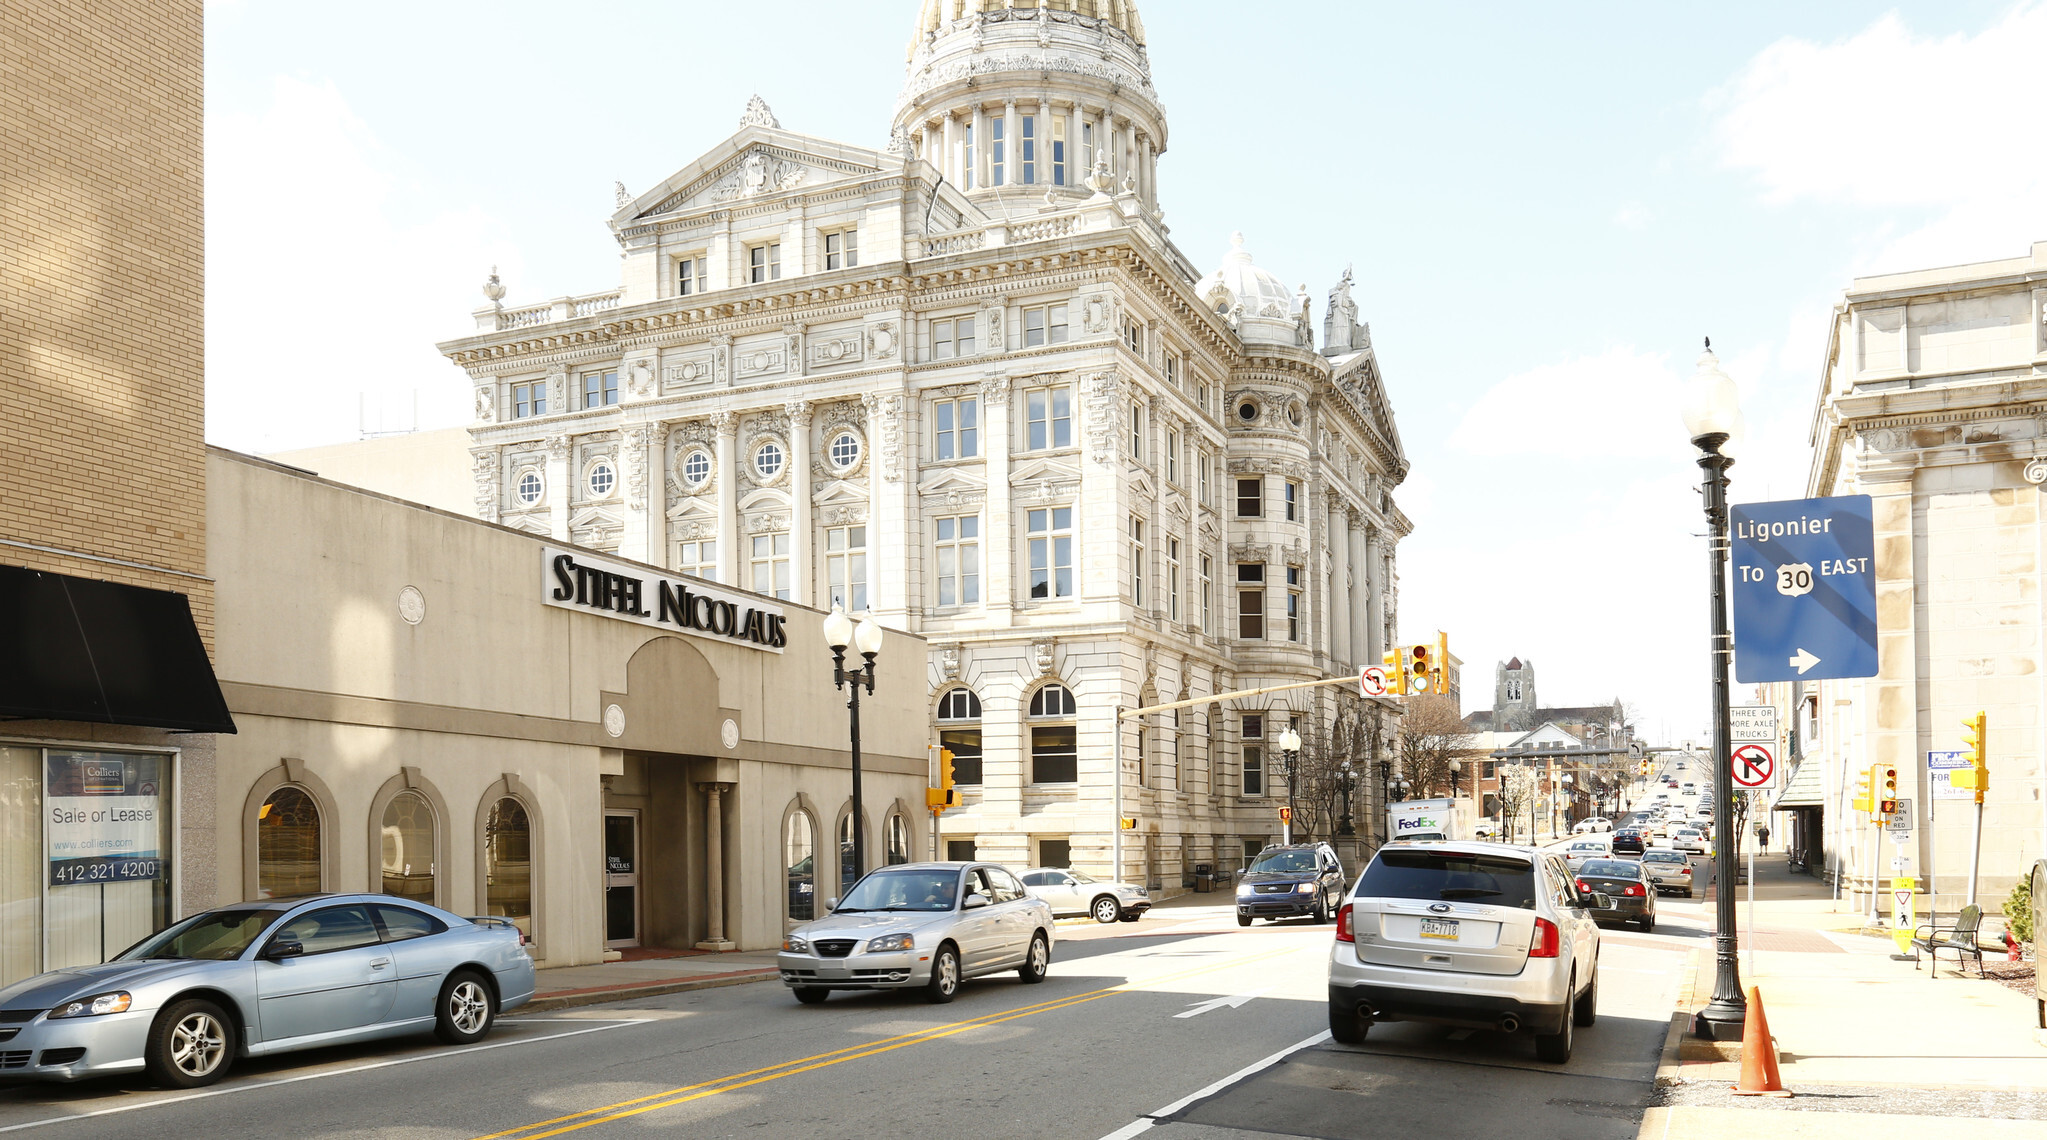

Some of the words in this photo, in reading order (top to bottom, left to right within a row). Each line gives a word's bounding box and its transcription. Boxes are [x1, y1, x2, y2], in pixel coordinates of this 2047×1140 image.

[1738, 516, 1832, 542] Ligonier
[1782, 571, 1810, 589] 30
[1821, 557, 1868, 576] EAST
[553, 554, 651, 617] STIFEL
[658, 580, 787, 648] NICOLAUS
[1731, 709, 1757, 717] THREE
[1761, 709, 1772, 717] OR
[1735, 730, 1768, 738] TRUCKS
[87, 767, 120, 777] Colliers
[53, 808, 86, 824] Sale
[91, 810, 106, 823] or
[111, 807, 153, 822] Lease
[1398, 817, 1437, 830] FedEx
[54, 839, 133, 850] www.colliers.com
[57, 865, 85, 881] 412
[89, 863, 115, 879] 321
[120, 861, 155, 877] 4200
